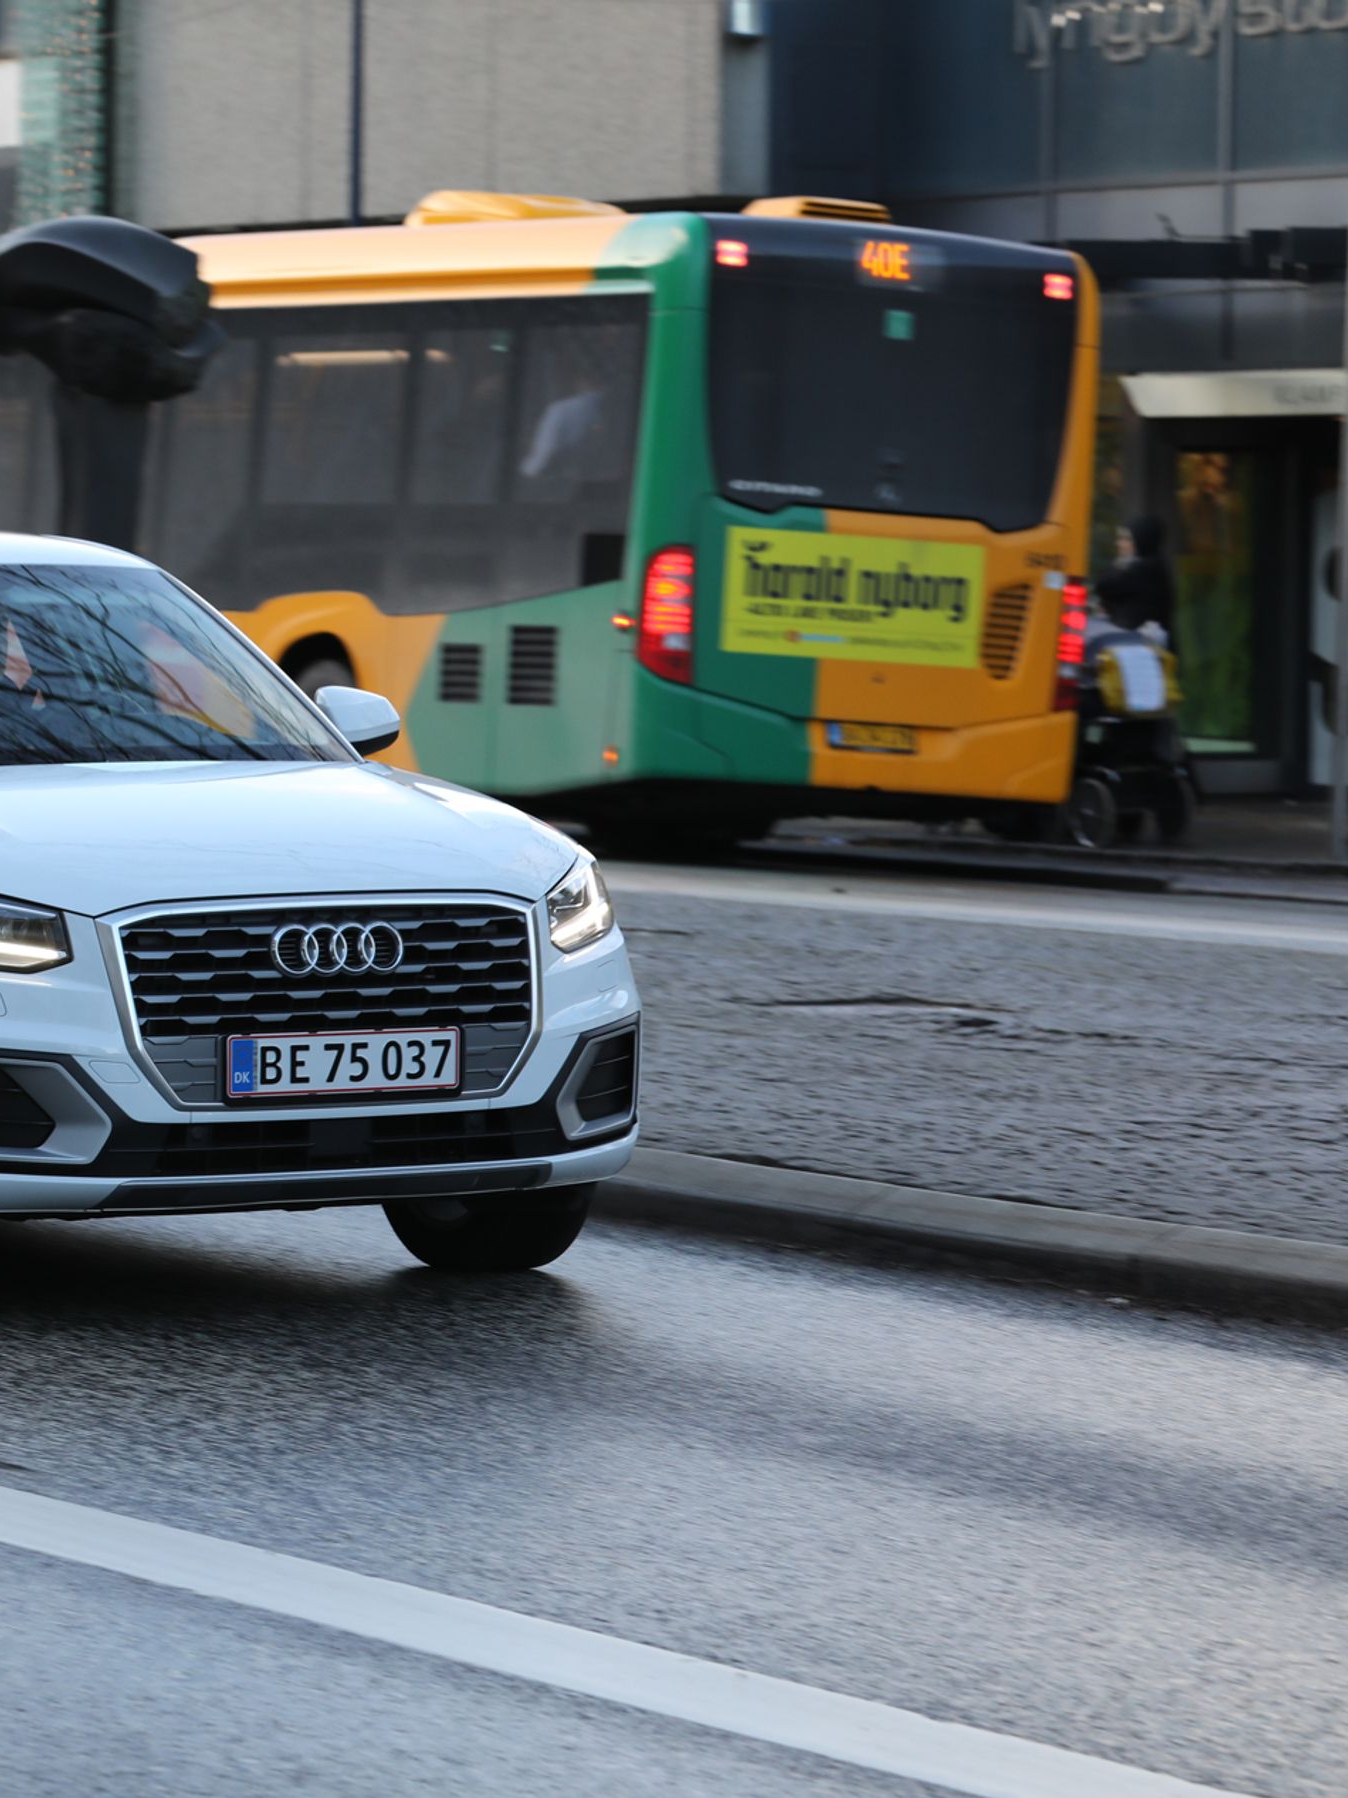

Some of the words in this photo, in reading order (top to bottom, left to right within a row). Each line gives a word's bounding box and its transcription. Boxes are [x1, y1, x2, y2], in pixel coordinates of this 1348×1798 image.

[860, 240, 911, 280] 40E
[234, 1071, 250, 1084] DK
[259, 1044, 311, 1086] BE
[323, 1041, 370, 1083] 75
[381, 1039, 452, 1081] 037
